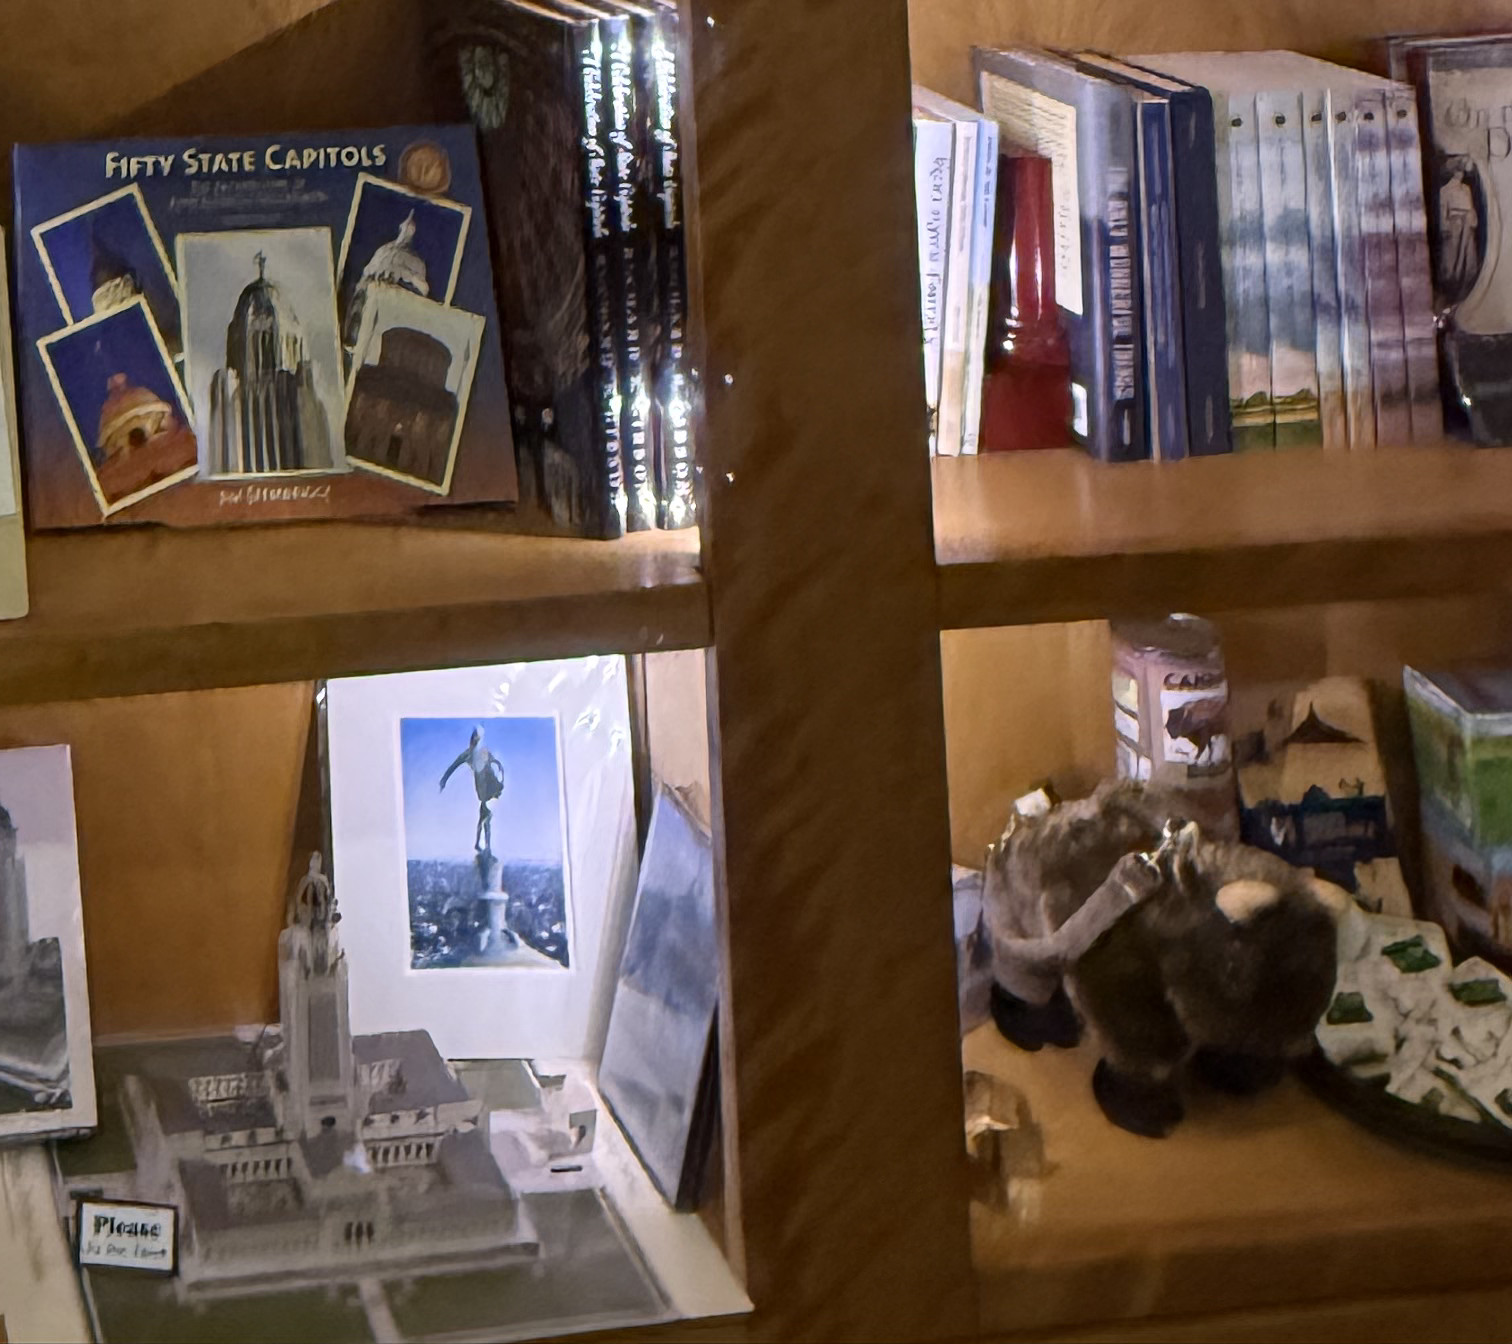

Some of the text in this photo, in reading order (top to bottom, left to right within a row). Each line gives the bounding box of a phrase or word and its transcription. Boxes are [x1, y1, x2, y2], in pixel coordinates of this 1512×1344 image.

[105, 144, 387, 179] FIFTY STATE CAPITOLS
[93, 1215, 162, 1238] Please
